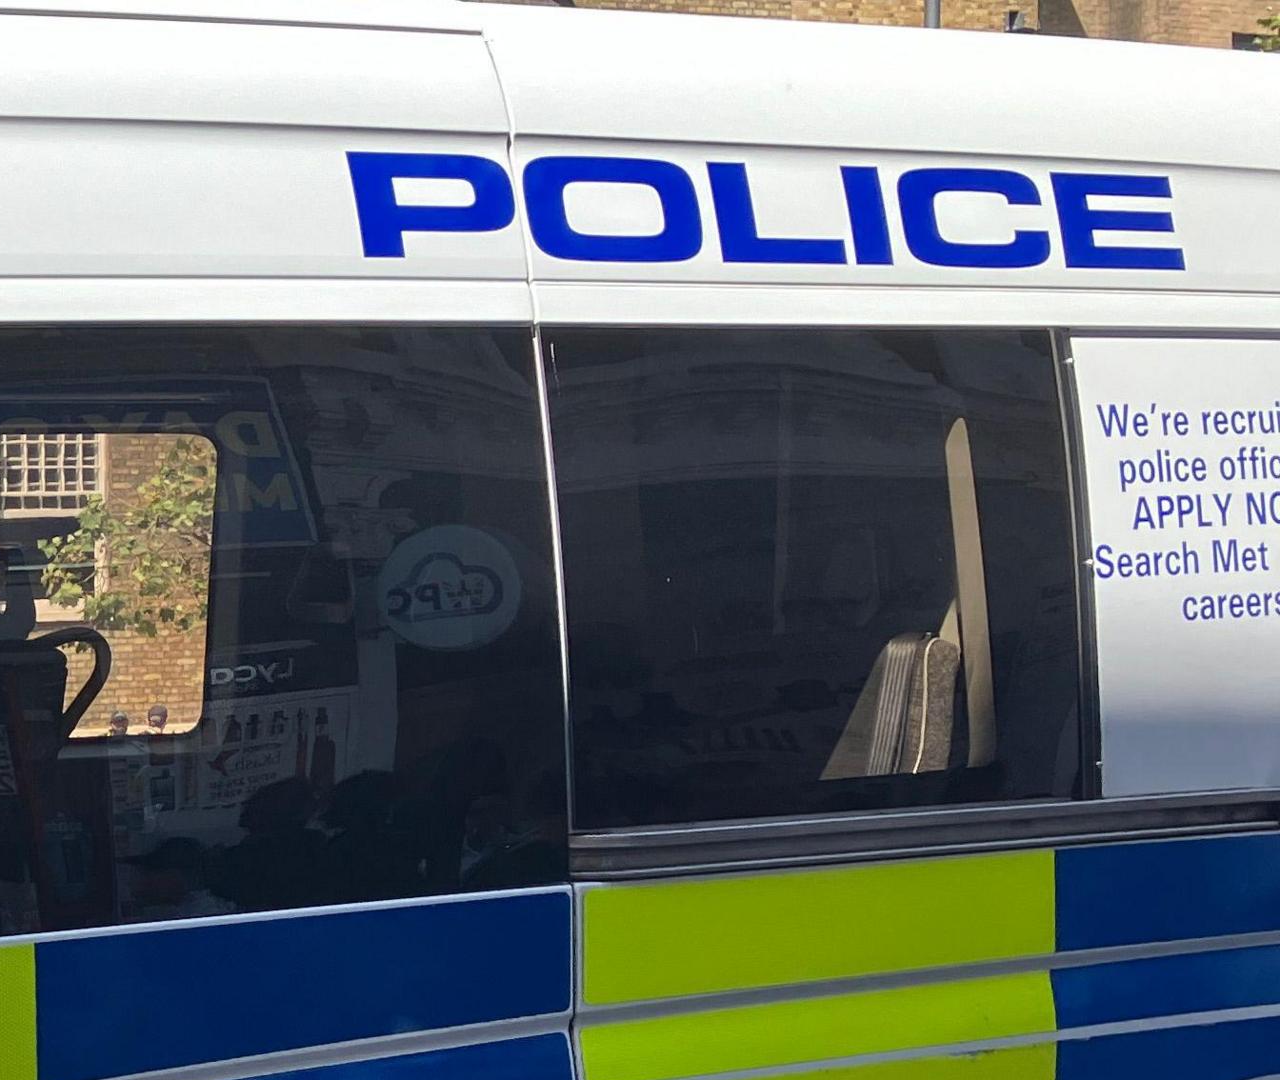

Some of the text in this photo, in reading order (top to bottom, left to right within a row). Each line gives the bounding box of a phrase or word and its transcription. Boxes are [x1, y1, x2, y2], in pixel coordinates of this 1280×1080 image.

[347, 152, 1185, 271] POLICE
[1096, 403, 1189, 438] We're
[1119, 448, 1209, 493] police
[1133, 493, 1232, 530] APPLY
[1095, 539, 1270, 579] Search Met
